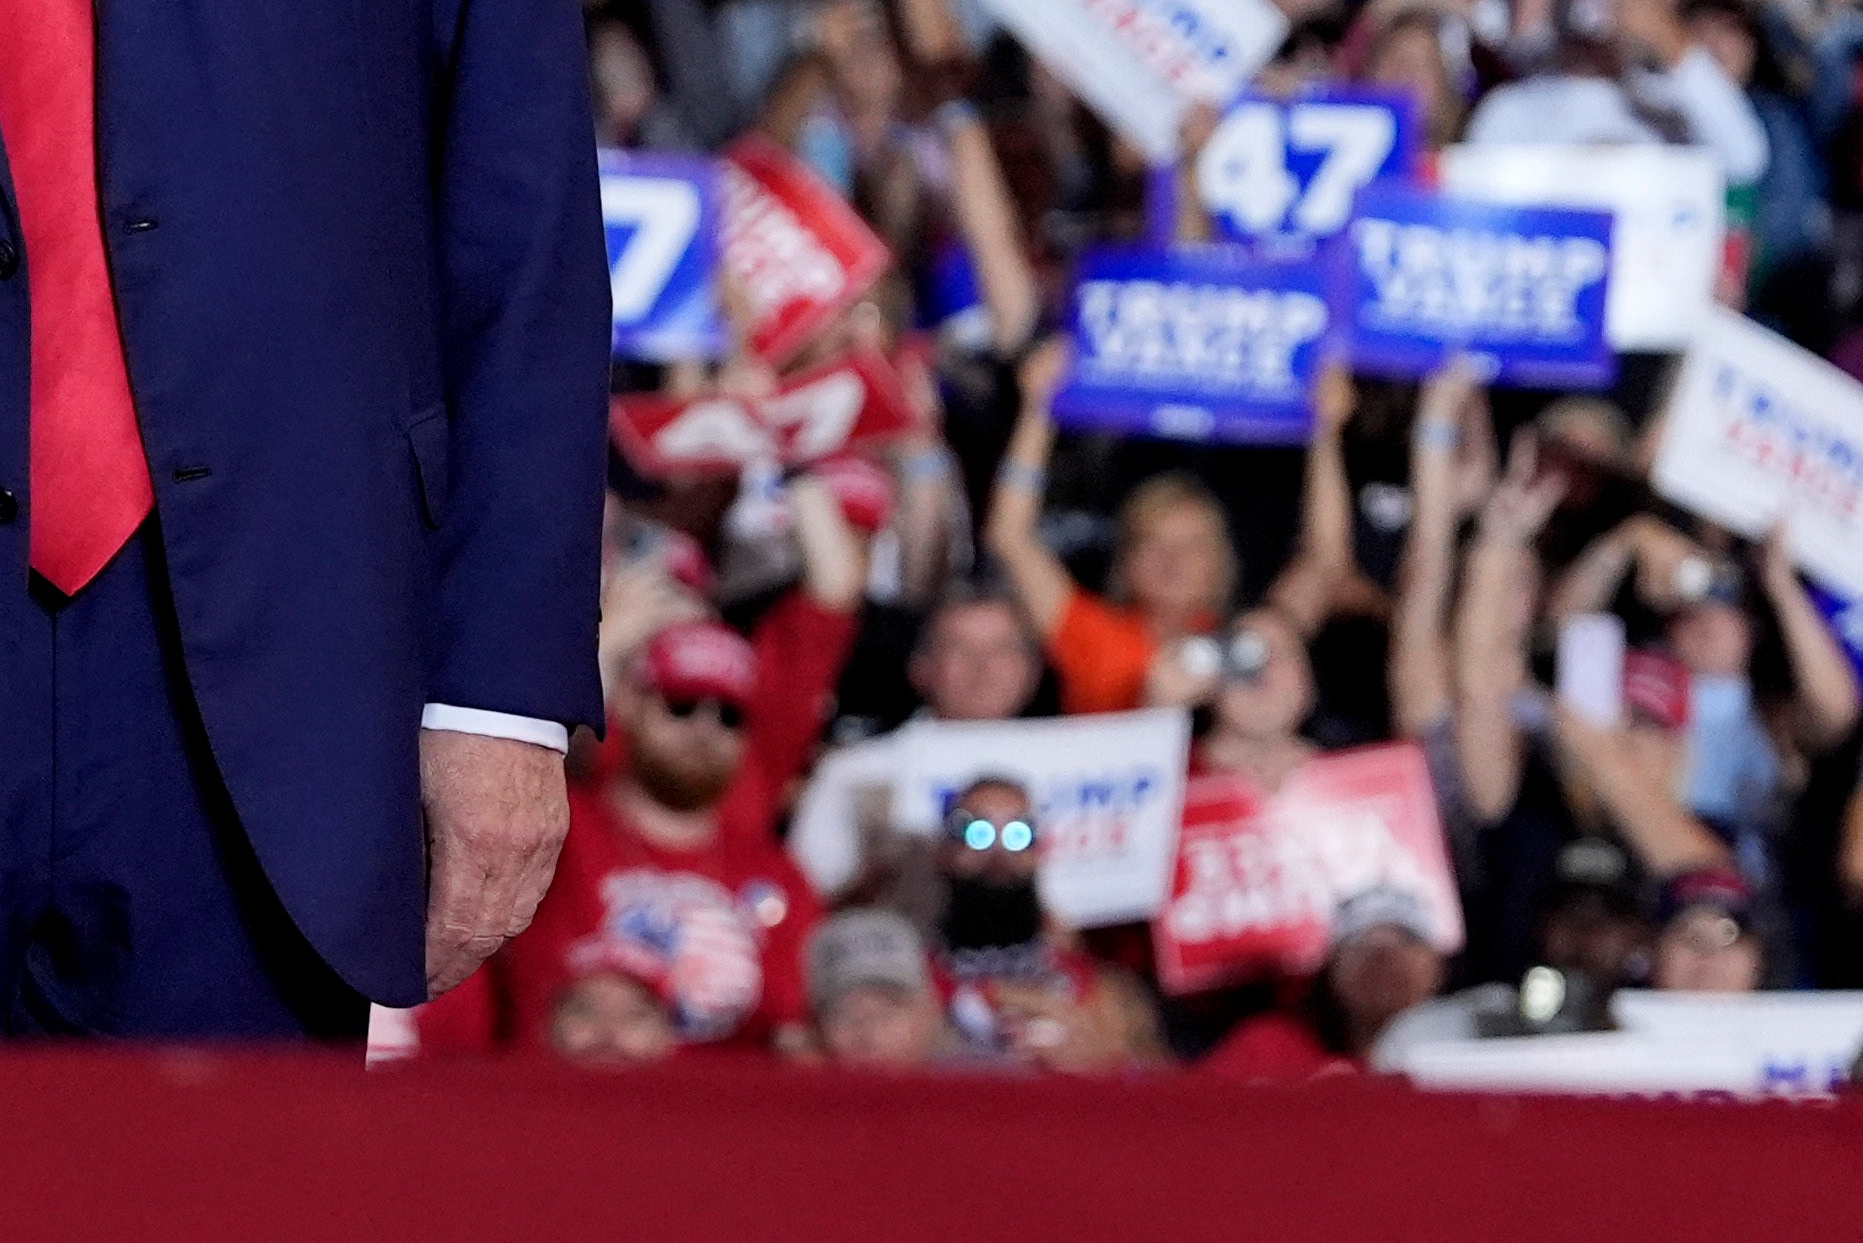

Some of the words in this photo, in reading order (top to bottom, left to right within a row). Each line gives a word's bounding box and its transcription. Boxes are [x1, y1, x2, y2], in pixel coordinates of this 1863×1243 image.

[1196, 103, 1395, 234] 47
[599, 176, 701, 323] 7
[1354, 218, 1606, 285] TRUMP
[1078, 281, 1328, 342] TRUMP
[1093, 325, 1294, 378] VANCE
[654, 370, 865, 462] 47
[1711, 366, 1863, 476] TRUM
